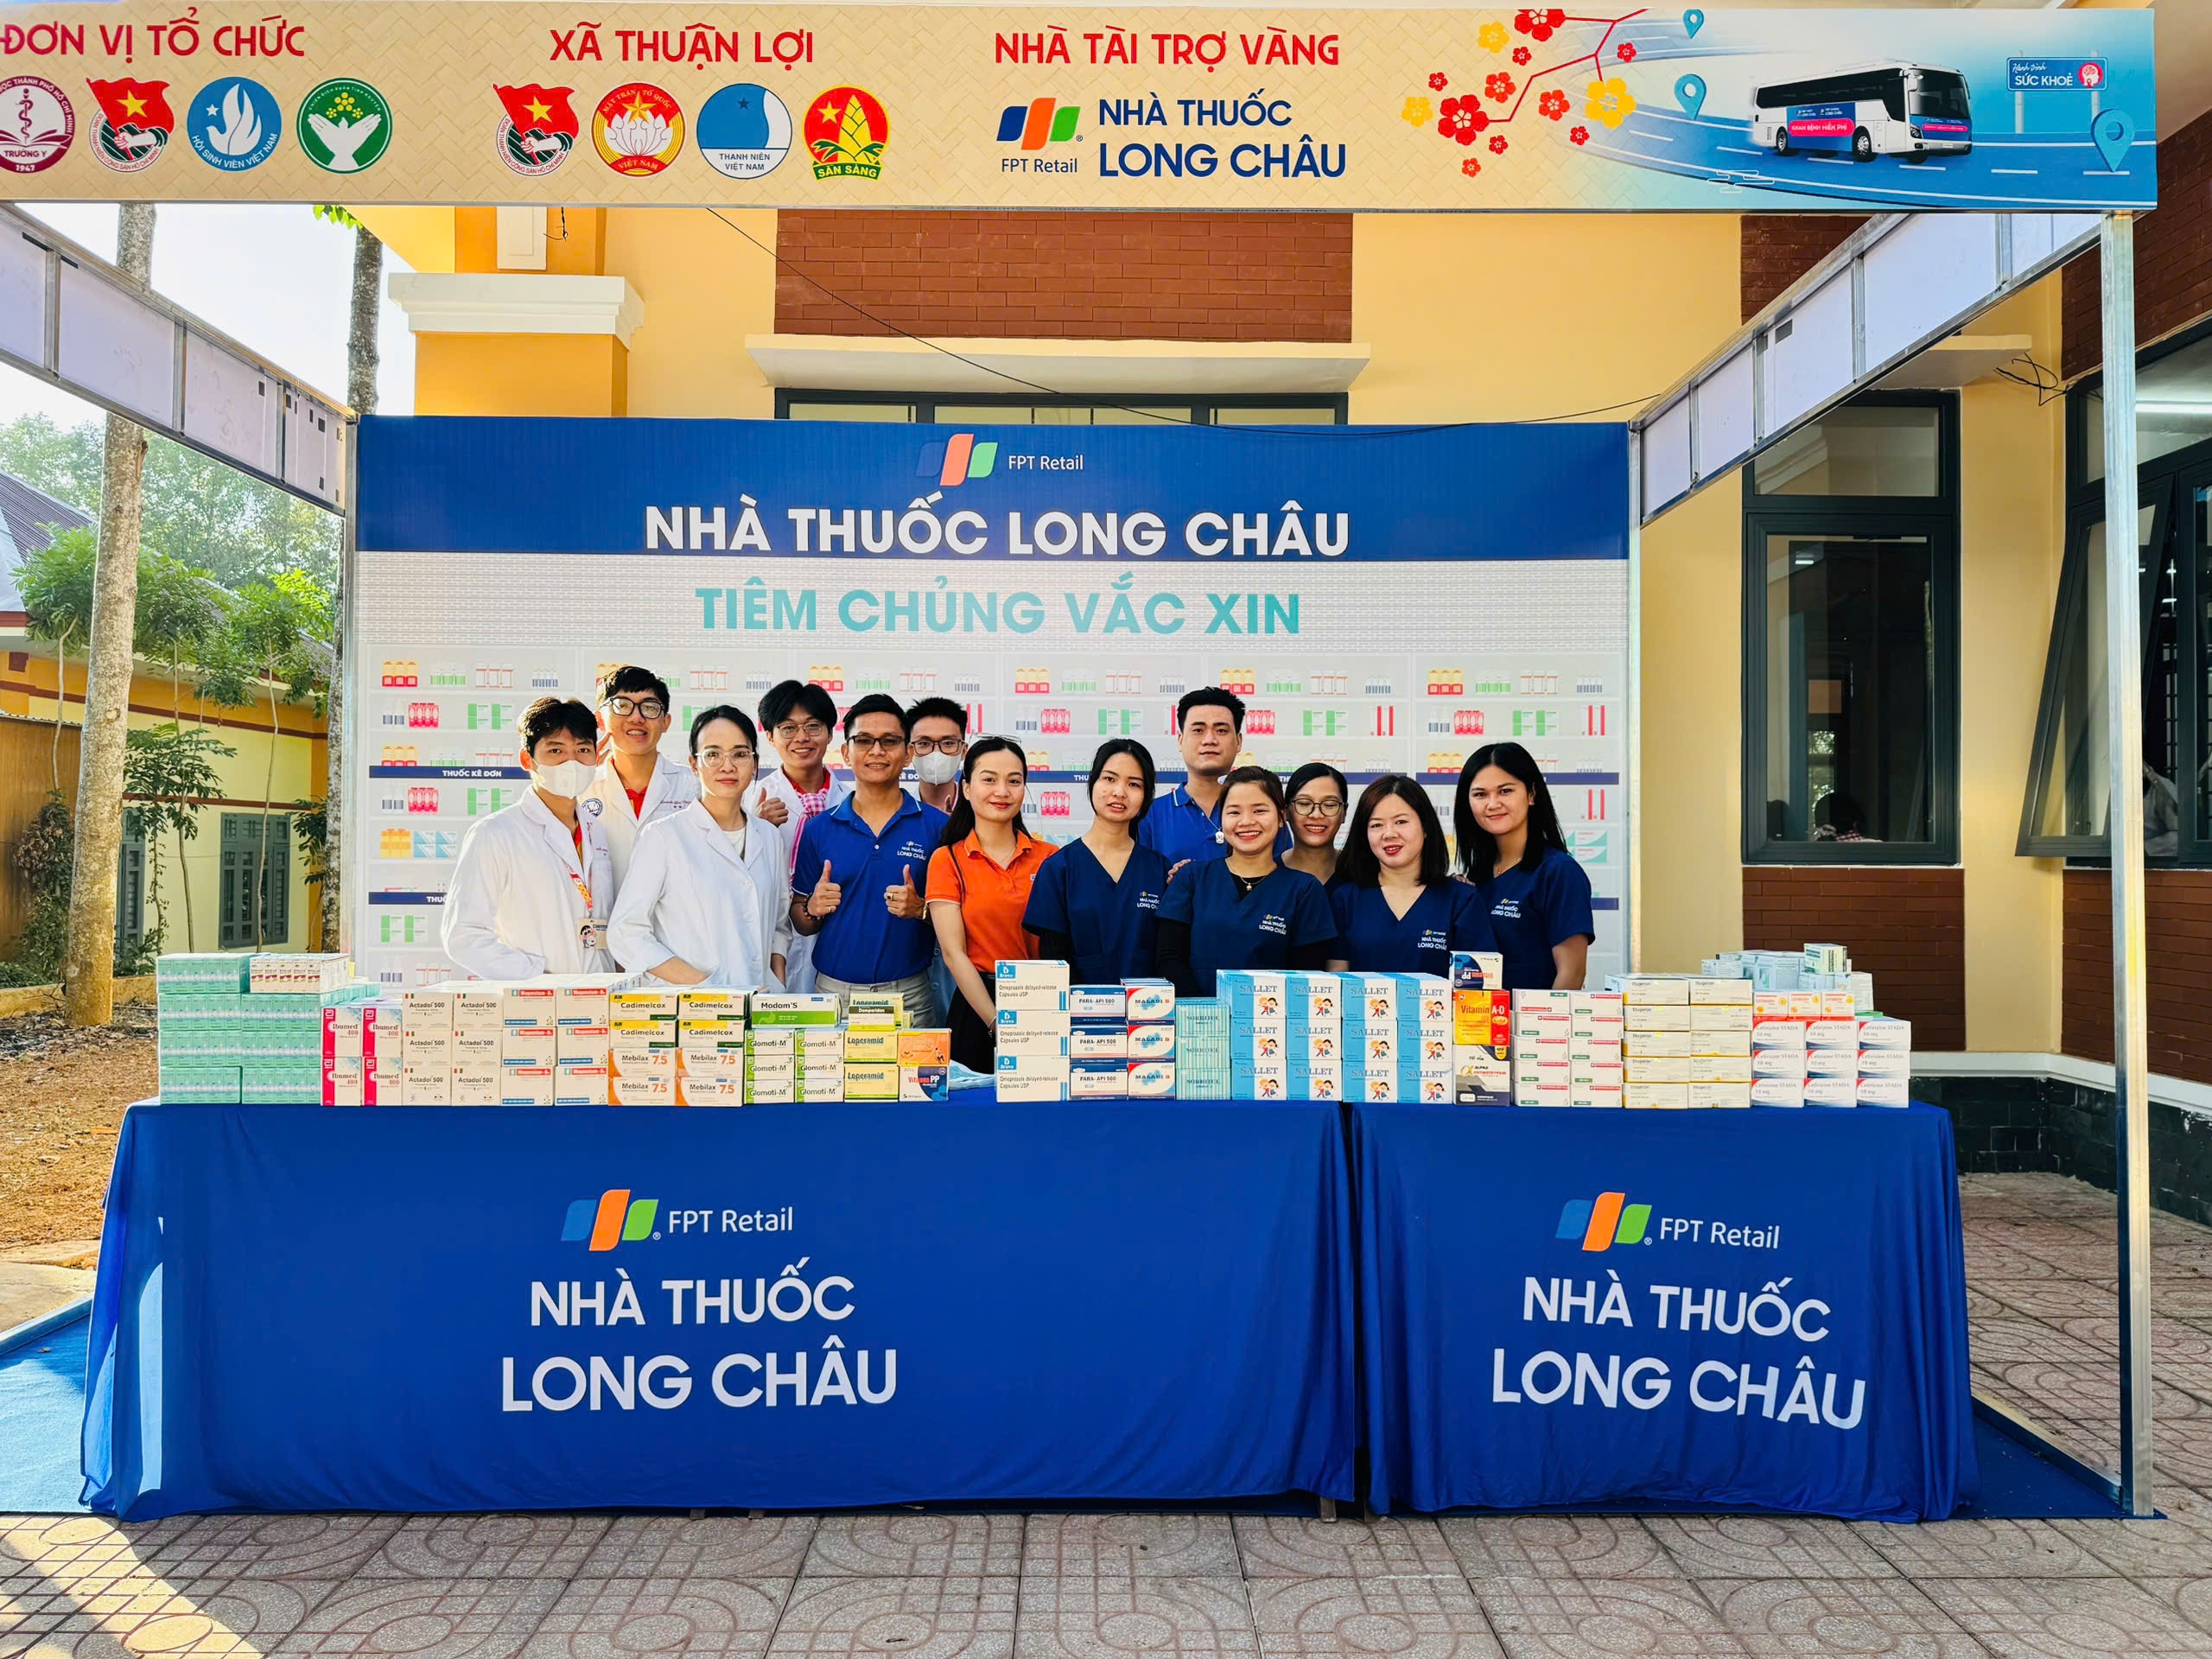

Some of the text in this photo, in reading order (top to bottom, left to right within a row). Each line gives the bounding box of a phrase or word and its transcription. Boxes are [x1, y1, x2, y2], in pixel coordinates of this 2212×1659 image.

[0, 6, 305, 64] ĐƠN VỊ TỔ CHỨC
[550, 21, 813, 71] XÃ THUẬN LỢI
[995, 24, 1338, 73] NHÀ TÀI TRỢ VÀNG
[2015, 72, 2038, 86] SỨC
[1099, 88, 1293, 126] NHÀ THUỐC
[191, 132, 279, 168] HỘI SINH VIÊN VIỆT NAM
[750, 151, 771, 161] NIÊN
[1100, 133, 1346, 178] LONG CHÂU
[639, 159, 659, 169] NAM
[725, 162, 744, 171] VIỆT
[845, 163, 877, 178] SÀNG
[1001, 158, 1078, 174] FPT Retail
[1007, 454, 1084, 471] FPT Retail
[645, 490, 1350, 556] NHÀ THUỐC LONG CHÂU
[695, 570, 1300, 635] TIÊM CHỦNG VẮC XIN
[442, 768, 502, 778] THUỐC KÊ ĐƠN
[1461, 1004, 1505, 1014] Vitamin A-D
[847, 1037, 885, 1046] Loperamid
[652, 1055, 668, 1065] 7.5
[720, 1055, 736, 1065] 7.5
[847, 1072, 885, 1081] Loperamid
[930, 1075, 940, 1084] PP
[1295, 1067, 1333, 1076] SALLET
[652, 1084, 668, 1093] 7.5
[719, 1084, 735, 1094] 7.5
[668, 1206, 793, 1233] FPT Retail
[1660, 1217, 1780, 1249] FPT Retail
[531, 1256, 855, 1327] NHÀ THUỐC
[1523, 1268, 1832, 1343] NHÀ THUỐC
[502, 1334, 897, 1412] LONG CHÂU
[1492, 1348, 1866, 1430] LONG CHÂU
